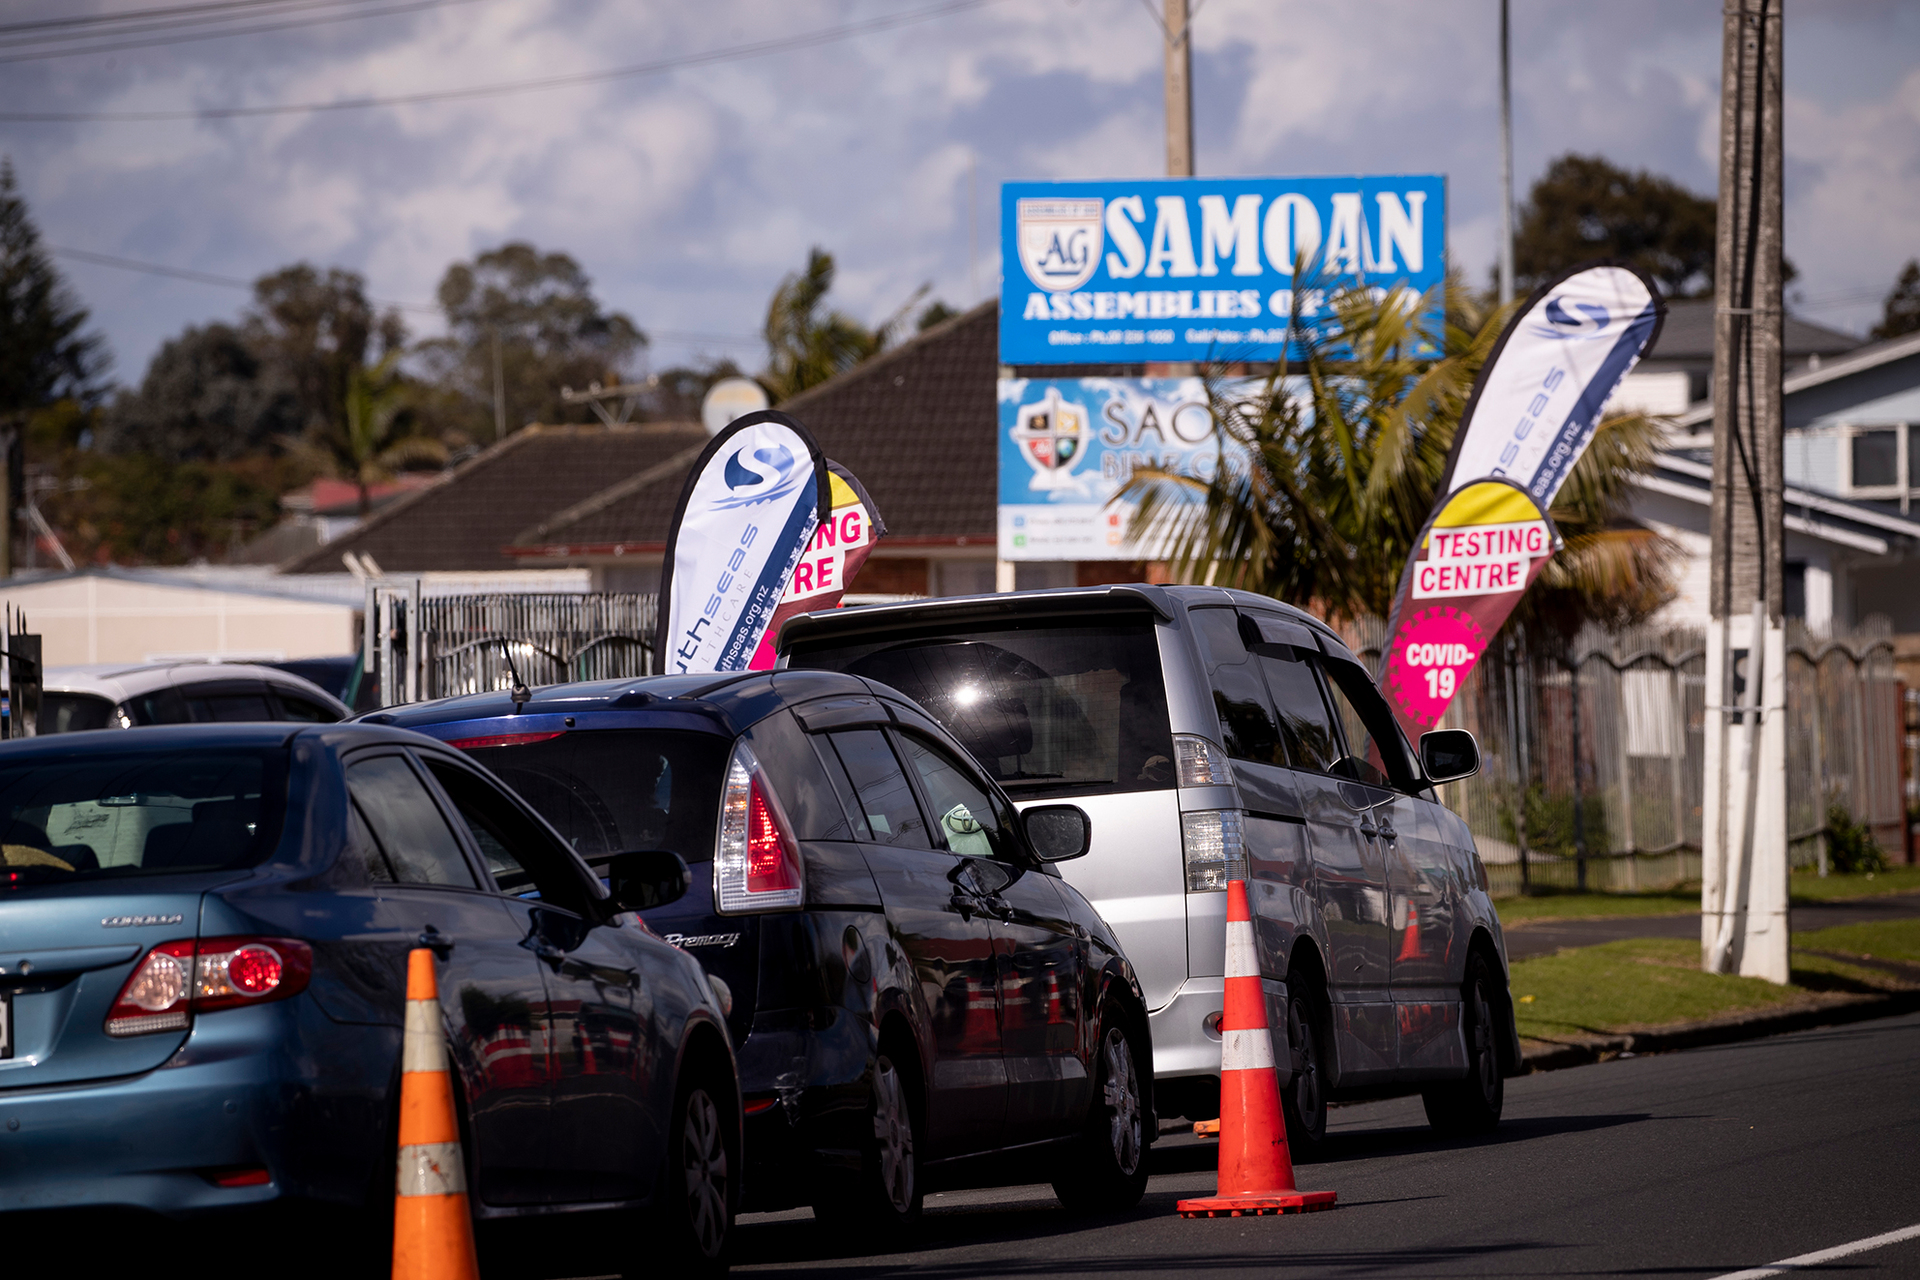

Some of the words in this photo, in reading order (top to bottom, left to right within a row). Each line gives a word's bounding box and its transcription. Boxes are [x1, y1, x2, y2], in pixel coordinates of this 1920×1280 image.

[1105, 191, 1427, 279] SAMOAN
[1023, 290, 1262, 320] ASSEMBLIES
[1102, 401, 1250, 443] SAO
[1435, 527, 1541, 558] TESTING
[783, 556, 834, 597] RE
[1420, 562, 1520, 592] CENTRE
[1406, 643, 1475, 667] COVID-
[1424, 667, 1455, 699] 19
[664, 932, 741, 949] Premacy
